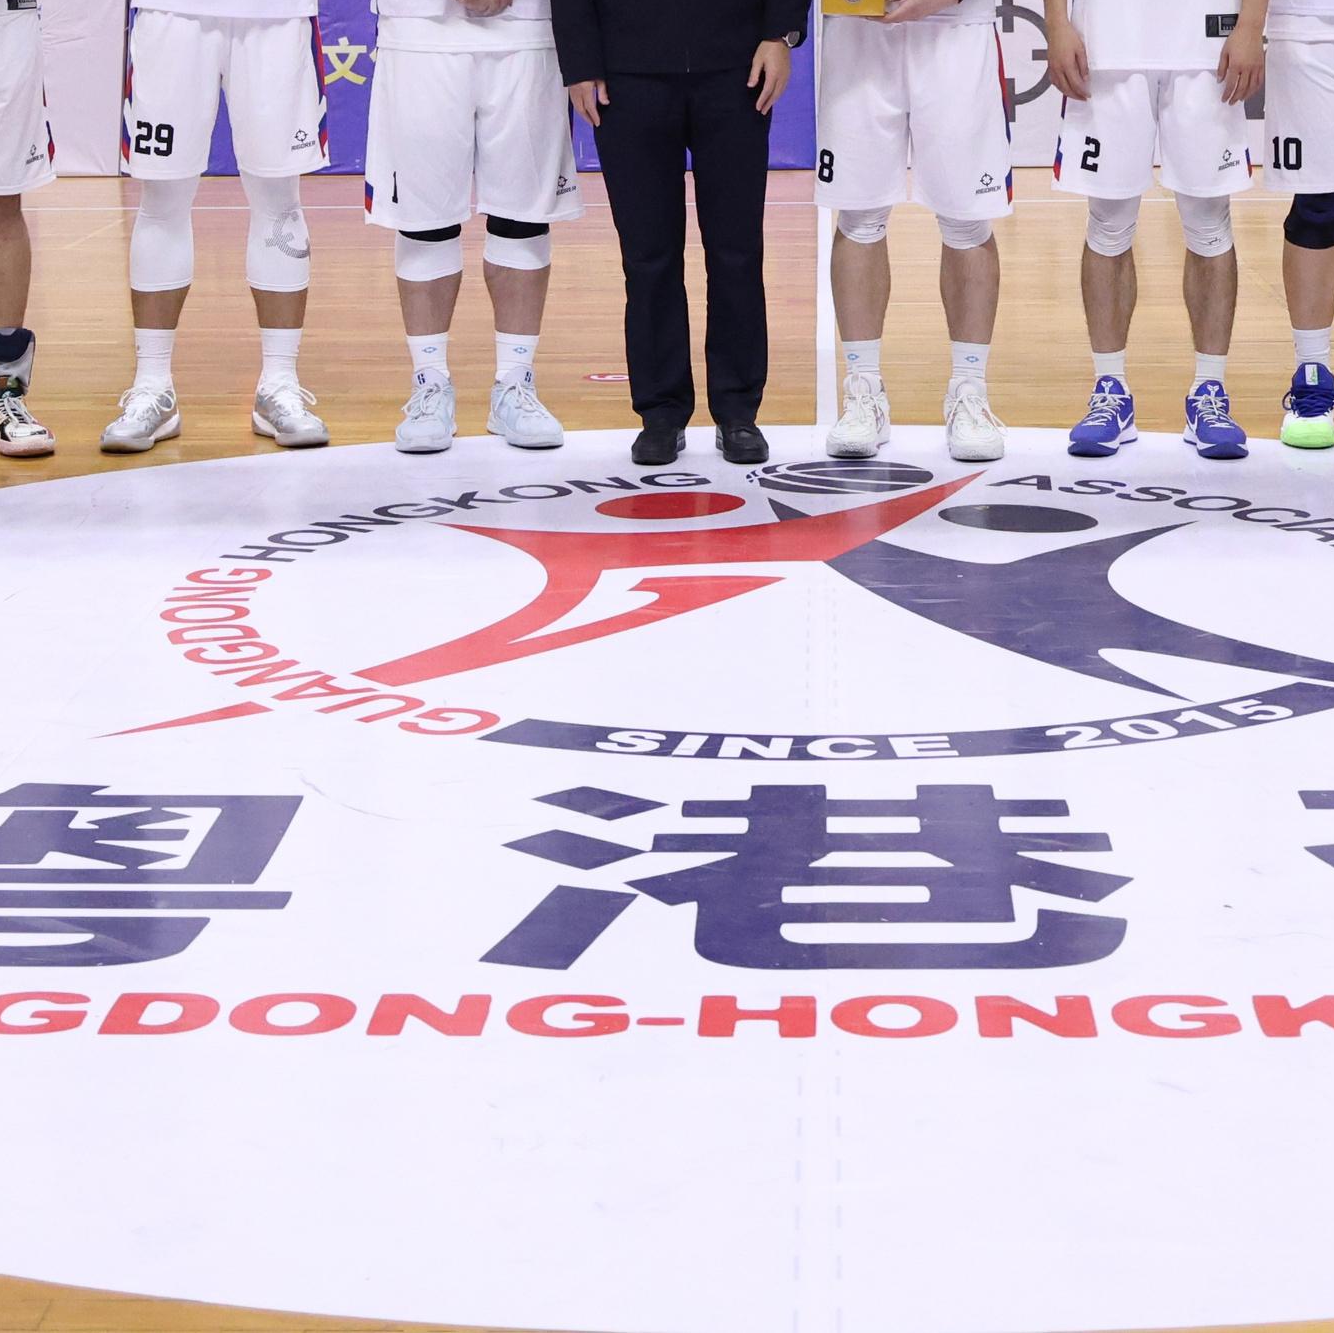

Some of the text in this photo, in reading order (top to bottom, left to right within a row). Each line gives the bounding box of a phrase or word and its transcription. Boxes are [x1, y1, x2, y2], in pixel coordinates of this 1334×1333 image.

[322, 36, 378, 85] 文
[135, 120, 174, 157] 29
[1081, 136, 1101, 173] 2
[1272, 136, 1302, 170] 10
[818, 148, 835, 183] 8
[220, 472, 711, 562] HONGKONG
[160, 568, 500, 736] GUANGDONG
[594, 699, 1294, 759] SINCE 2015
